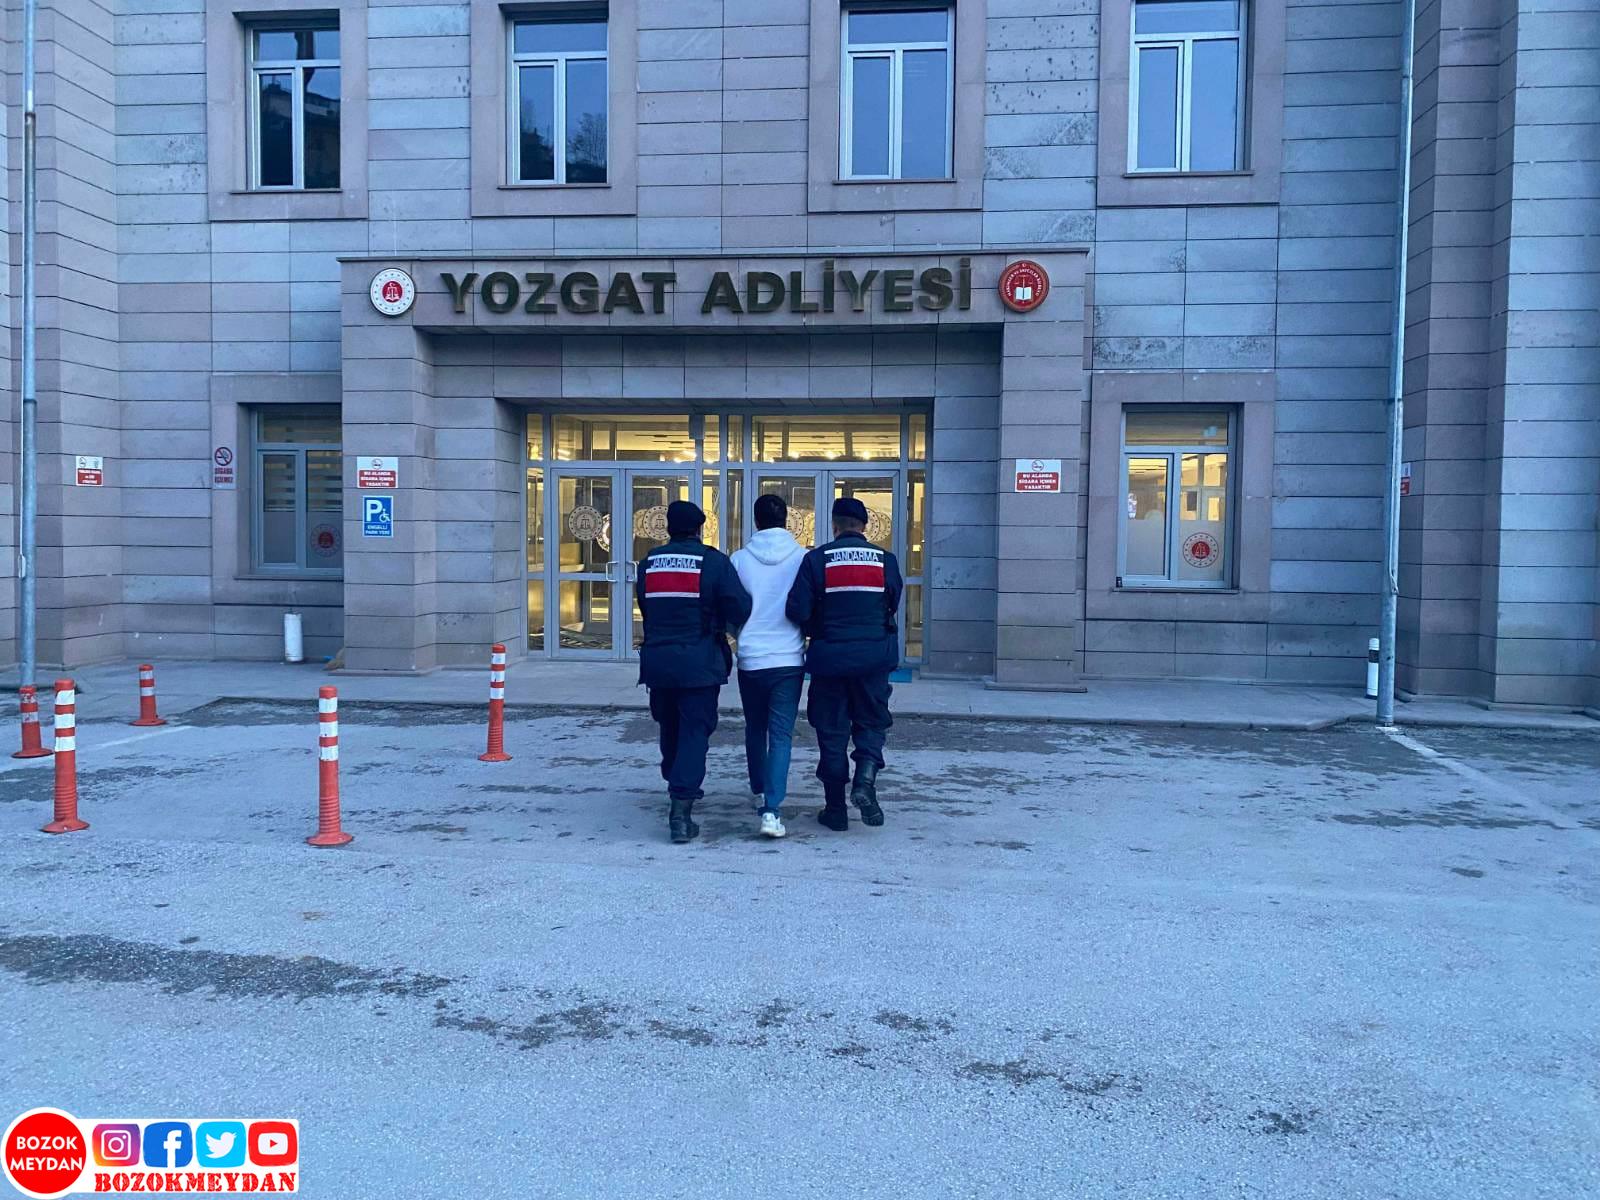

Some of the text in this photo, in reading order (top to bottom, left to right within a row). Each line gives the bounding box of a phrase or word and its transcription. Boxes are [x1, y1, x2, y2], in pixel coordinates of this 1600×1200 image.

[440, 257, 971, 314] YOZGAT ADLİYESİ
[366, 500, 383, 521] P
[650, 557, 697, 569] JANDARMA
[831, 550, 880, 562] JANDARMA
